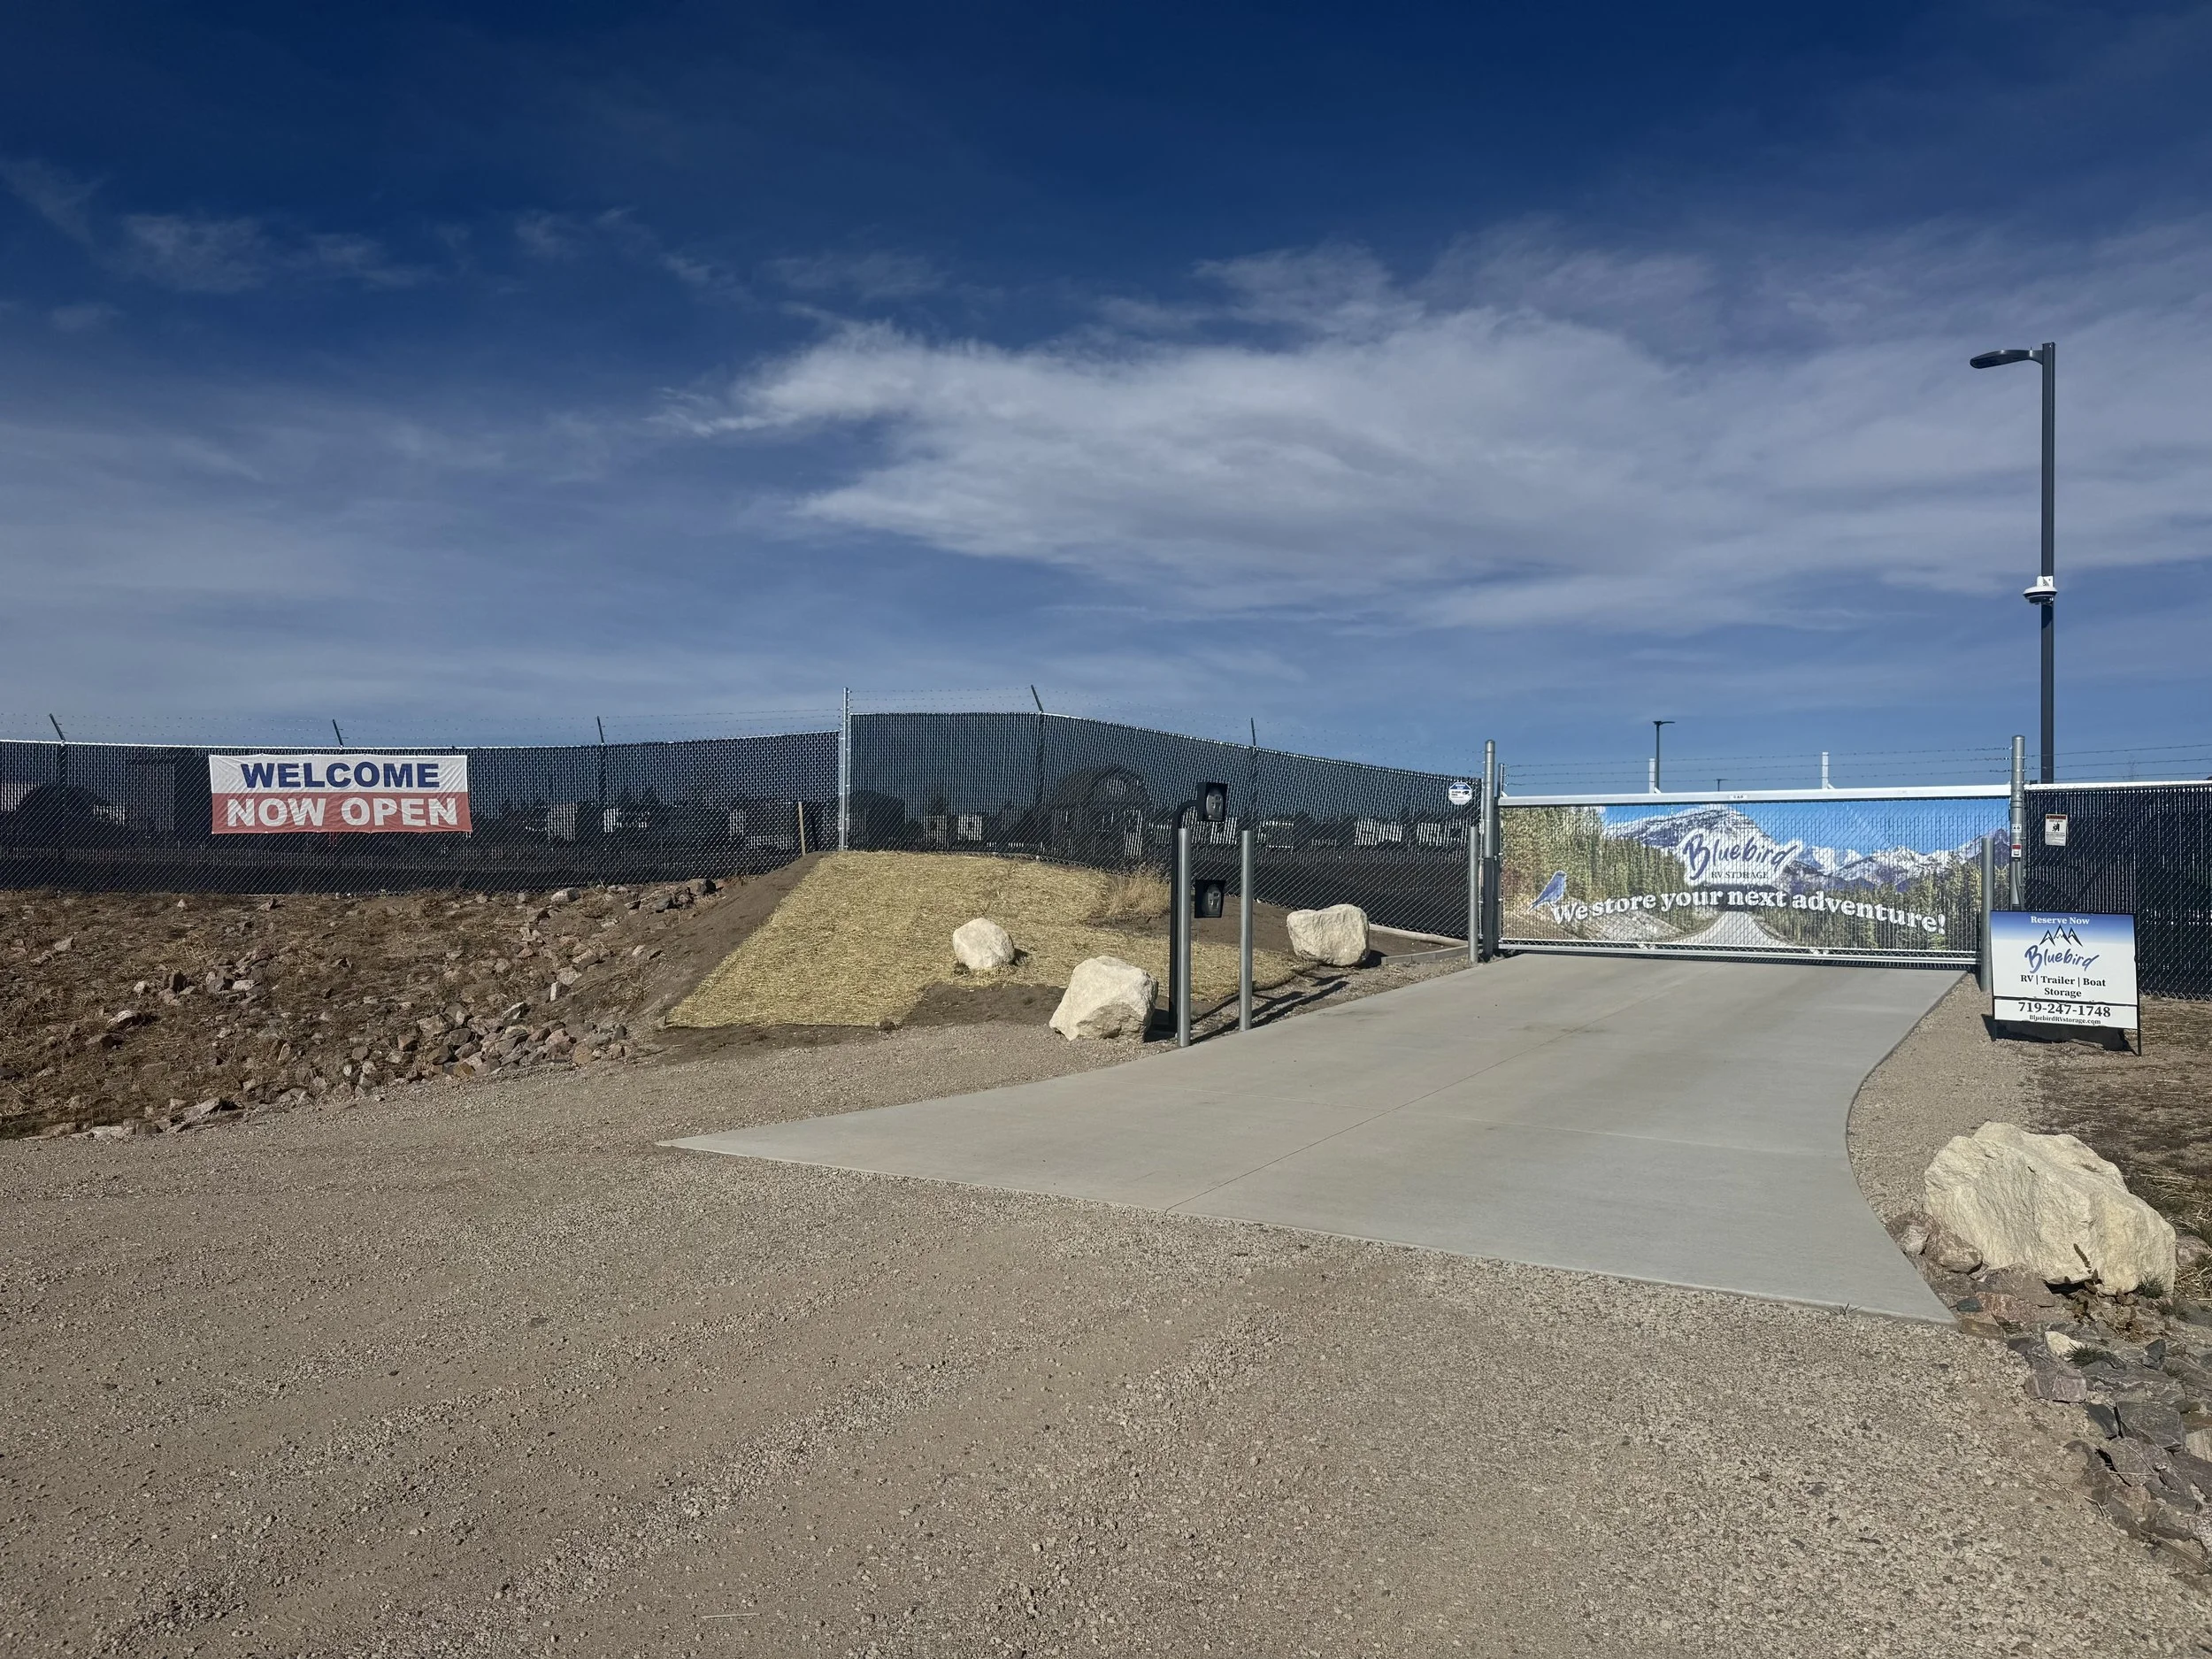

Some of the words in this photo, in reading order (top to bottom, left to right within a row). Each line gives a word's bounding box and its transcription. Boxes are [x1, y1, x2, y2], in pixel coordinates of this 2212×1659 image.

[241, 761, 440, 788] WELCOME
[227, 797, 326, 826] NOW
[341, 797, 457, 827] OPEN
[1682, 833, 1798, 880] Bluebird
[1551, 902, 1588, 925] We
[1592, 894, 1655, 917] store
[1660, 889, 1724, 912] your
[1727, 890, 1787, 908] next
[1792, 891, 1946, 934] adventure!
[2031, 916, 2068, 925] Reserve
[2024, 944, 2101, 974] Bluebird
[2020, 974, 2034, 983] RV
[2040, 975, 2076, 985] Trailer
[2083, 978, 2107, 987] Boat
[2044, 987, 2082, 999] Storage
[2018, 1002, 2111, 1018] 719-247-1748
[2029, 1014, 2101, 1025] BluebirdRVstorage.com
